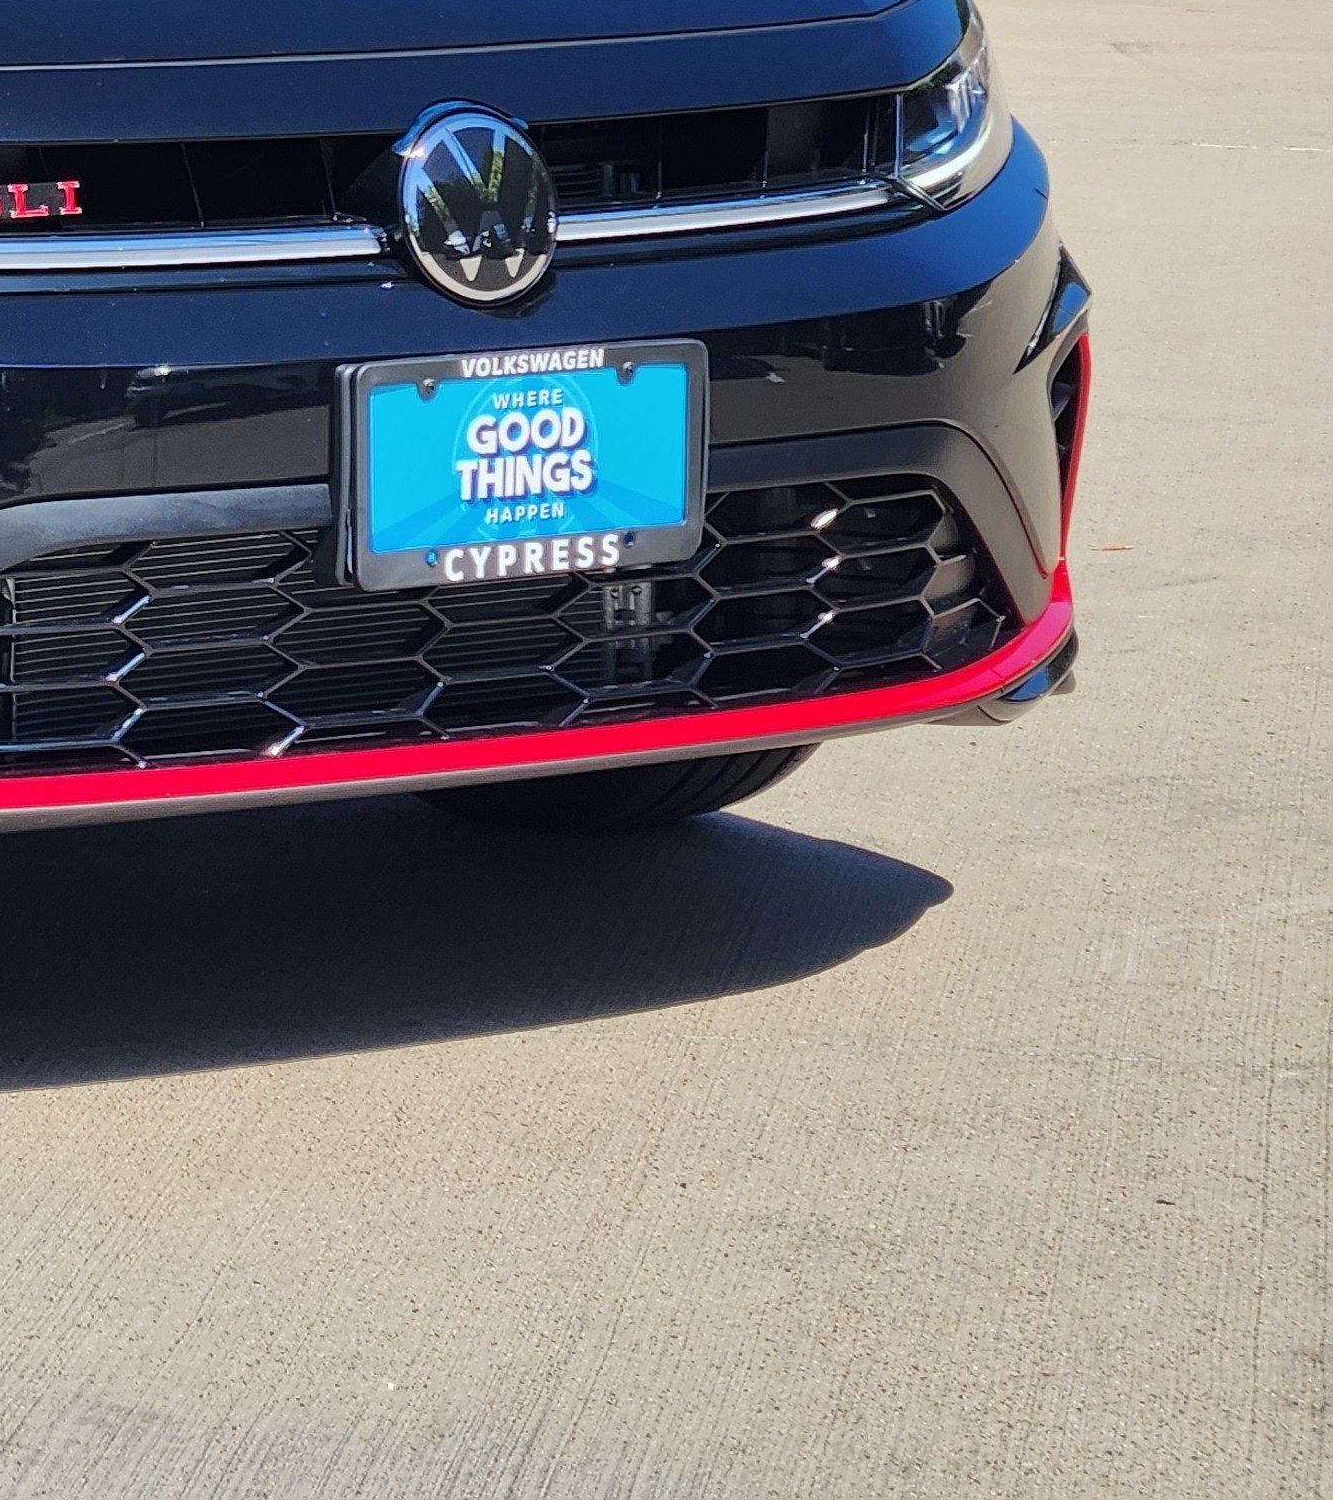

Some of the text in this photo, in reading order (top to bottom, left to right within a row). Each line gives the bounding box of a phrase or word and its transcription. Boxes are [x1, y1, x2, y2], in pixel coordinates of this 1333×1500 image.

[461, 347, 605, 378] VOLKSWAGEN
[492, 388, 564, 409] WHERE
[466, 406, 587, 456] GOOD
[456, 449, 595, 501] THINGS
[485, 503, 566, 524] HAPPEN
[443, 534, 621, 582] CYPRESS
